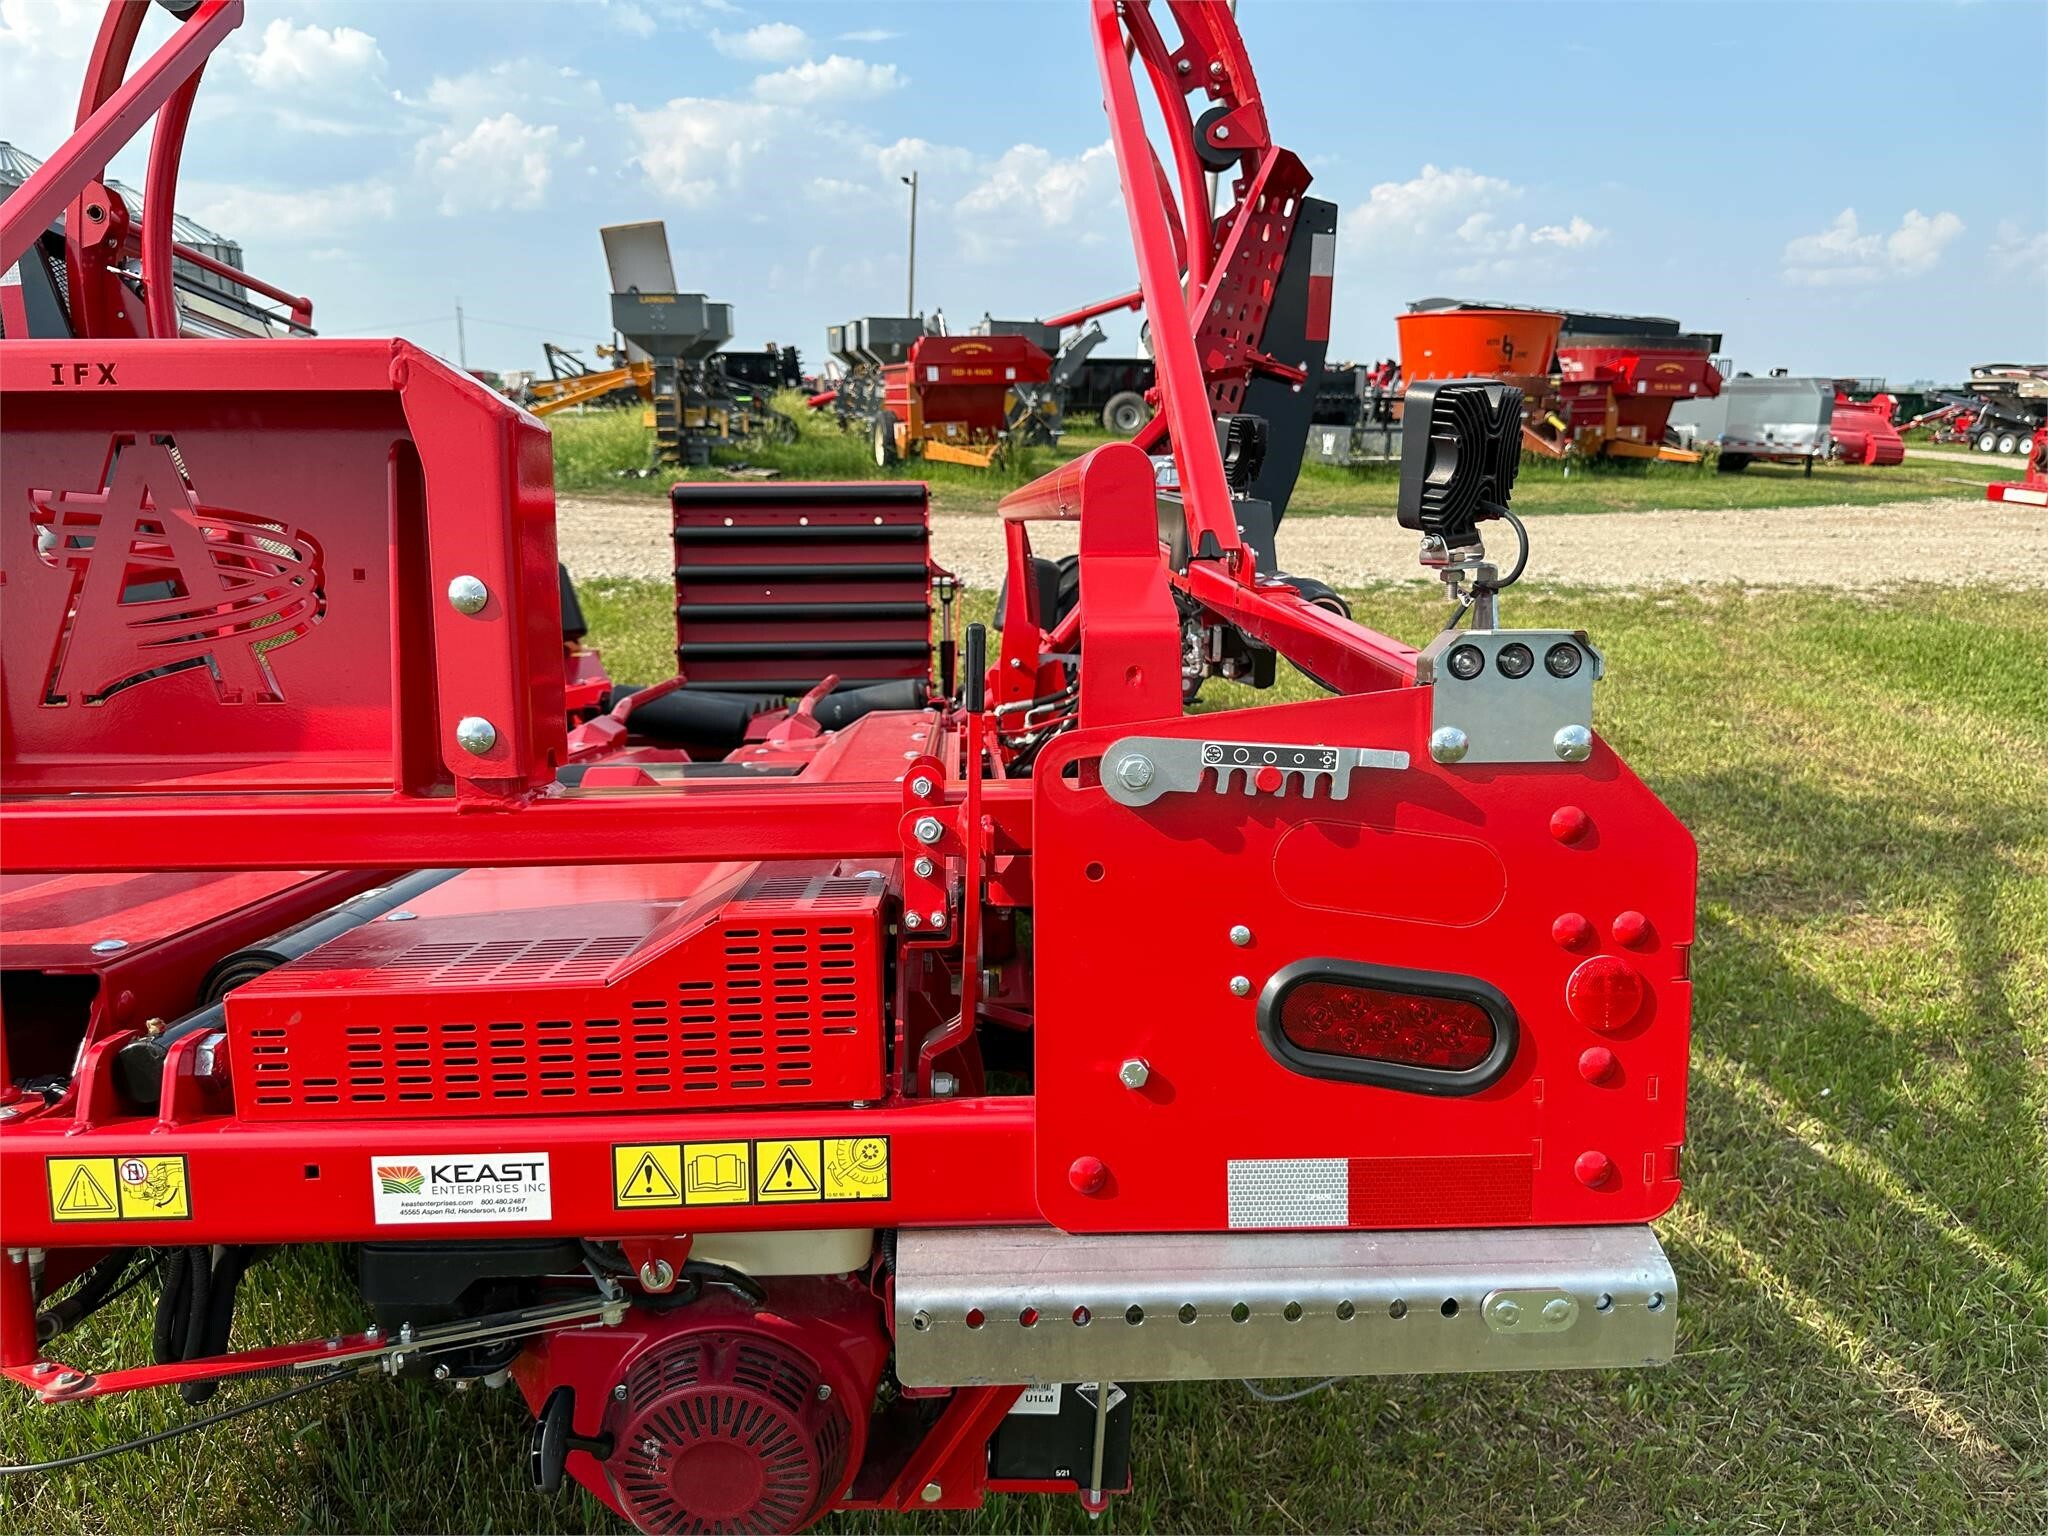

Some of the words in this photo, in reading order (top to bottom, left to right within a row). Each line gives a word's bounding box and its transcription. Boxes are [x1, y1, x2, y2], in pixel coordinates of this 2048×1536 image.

[51, 363, 118, 385] IFX
[431, 1162, 545, 1184] KEAST
[432, 1184, 519, 1195] ENTERPRISES
[524, 1183, 546, 1193] INC
[401, 1199, 474, 1207] keastenterprises.com
[480, 1197, 526, 1205] 800.480.2487
[400, 1208, 421, 1216] 45565
[421, 1208, 444, 1216] Aspen
[458, 1206, 497, 1214] Henderson,
[1025, 1394, 1054, 1402] U1LM
[1055, 1469, 1070, 1477] 5/21
